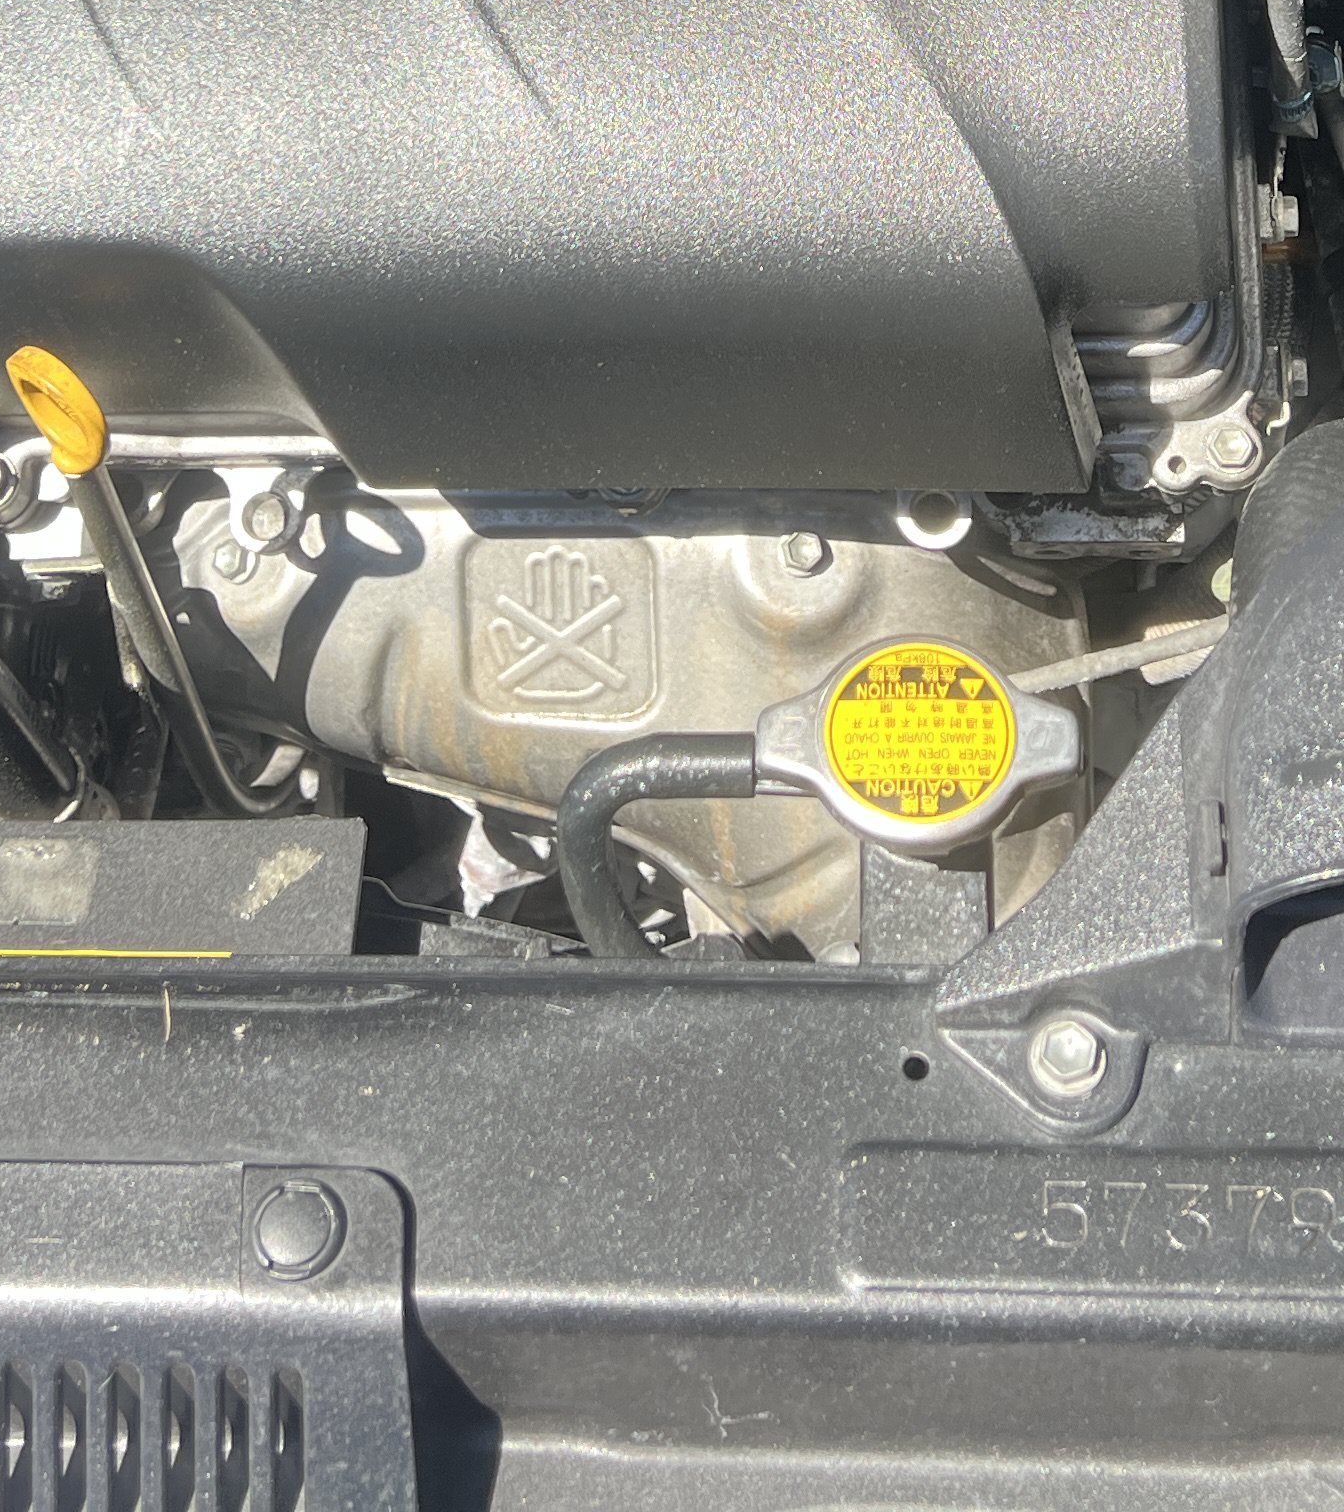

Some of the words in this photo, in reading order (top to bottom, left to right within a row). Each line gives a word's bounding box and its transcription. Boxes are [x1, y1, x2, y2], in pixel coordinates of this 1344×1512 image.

[895, 653, 940, 665] 108kPa
[856, 681, 950, 700] ATTENTION
[844, 732, 880, 745] CHAUD
[897, 732, 935, 744] OUVRIR
[940, 732, 977, 744] JAMAIS
[982, 733, 996, 744] NE
[846, 748, 869, 760] HOT
[877, 748, 910, 760] WHEN
[918, 748, 950, 760] OPEN
[958, 749, 997, 761] NEVER
[866, 779, 956, 798] CAUTION
